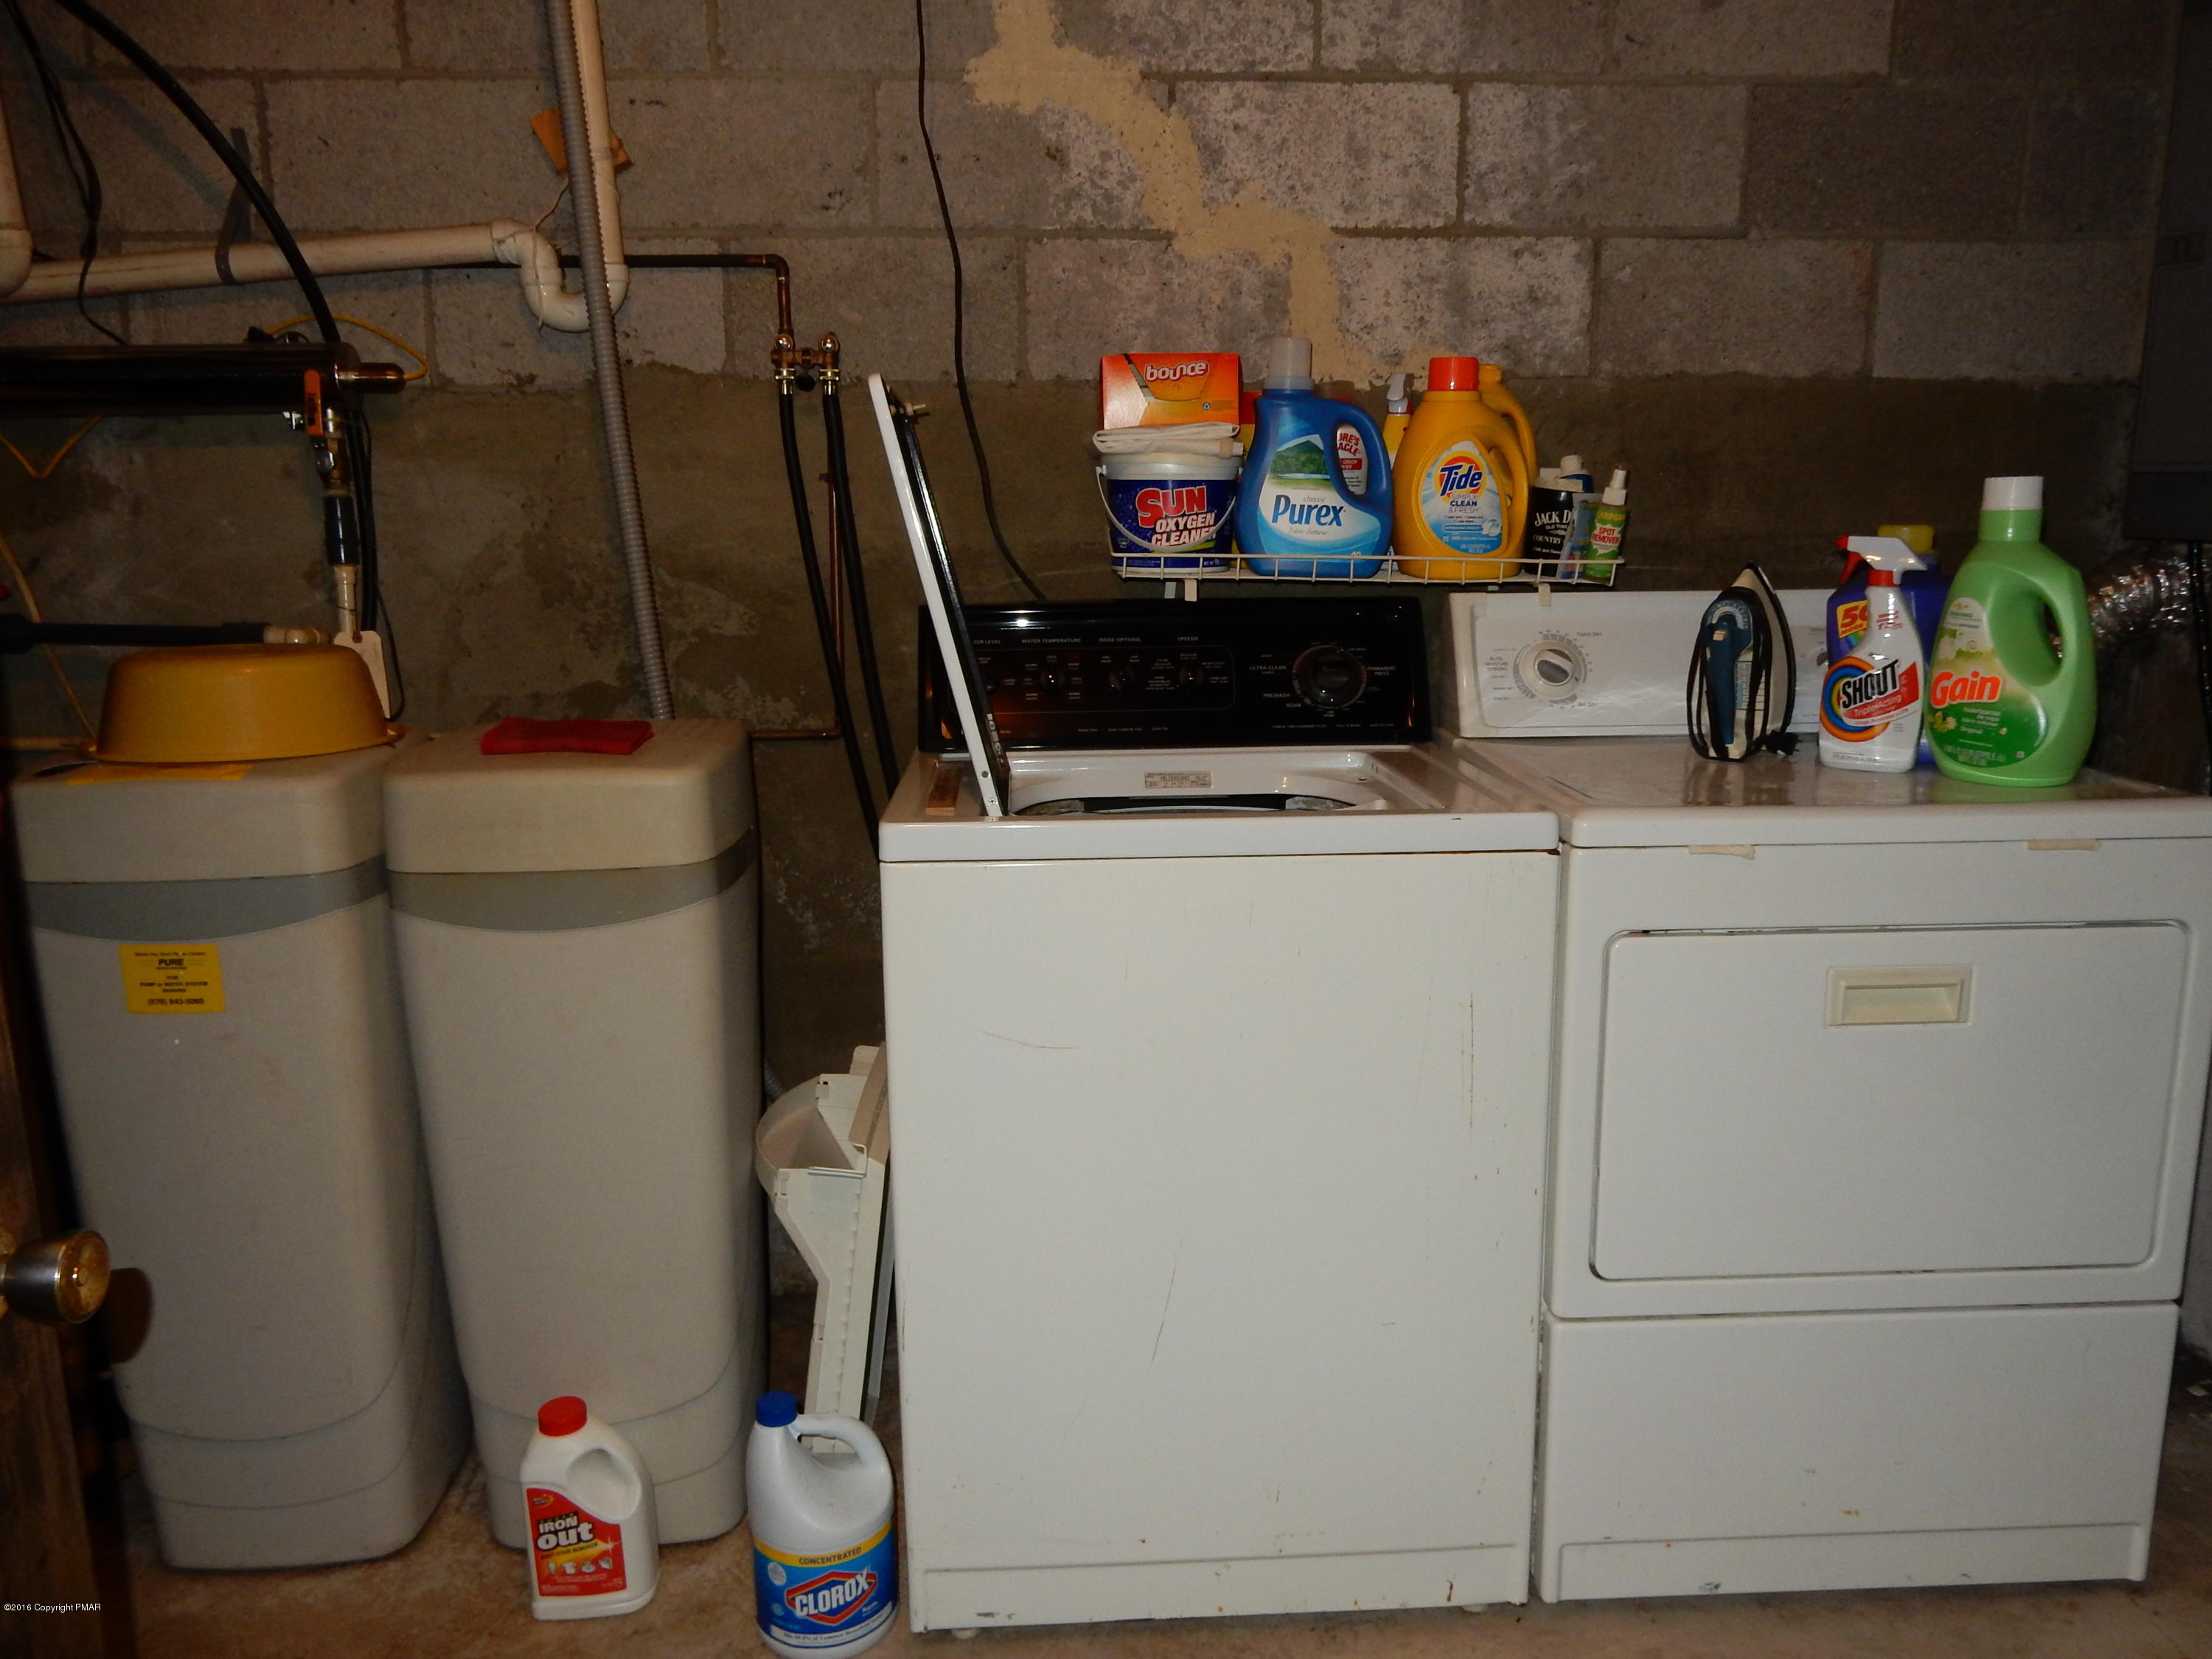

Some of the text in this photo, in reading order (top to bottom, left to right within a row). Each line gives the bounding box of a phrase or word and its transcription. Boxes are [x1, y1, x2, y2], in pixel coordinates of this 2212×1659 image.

[1145, 360, 1208, 382] bounce
[1338, 442, 1360, 456] ACLE
[1440, 465, 1483, 497] Tide
[1135, 485, 1207, 528] SUN
[1303, 495, 1326, 503] classic
[1450, 493, 1478, 501] SIMPLY
[1271, 494, 1344, 526] Purex
[1534, 511, 1560, 527] JACK
[1155, 512, 1216, 533] OXYGEN
[1599, 526, 1616, 536] SPOT
[1591, 533, 1621, 544] REMOVER
[1841, 658, 1899, 709] SHOUT
[1930, 670, 2002, 708] Gain
[158, 958, 184, 967] PURE
[539, 1515, 578, 1534] IRON
[537, 1521, 594, 1551] out
[799, 1547, 862, 1565] CONCENTRATED
[794, 1565, 872, 1617] CLOROX
